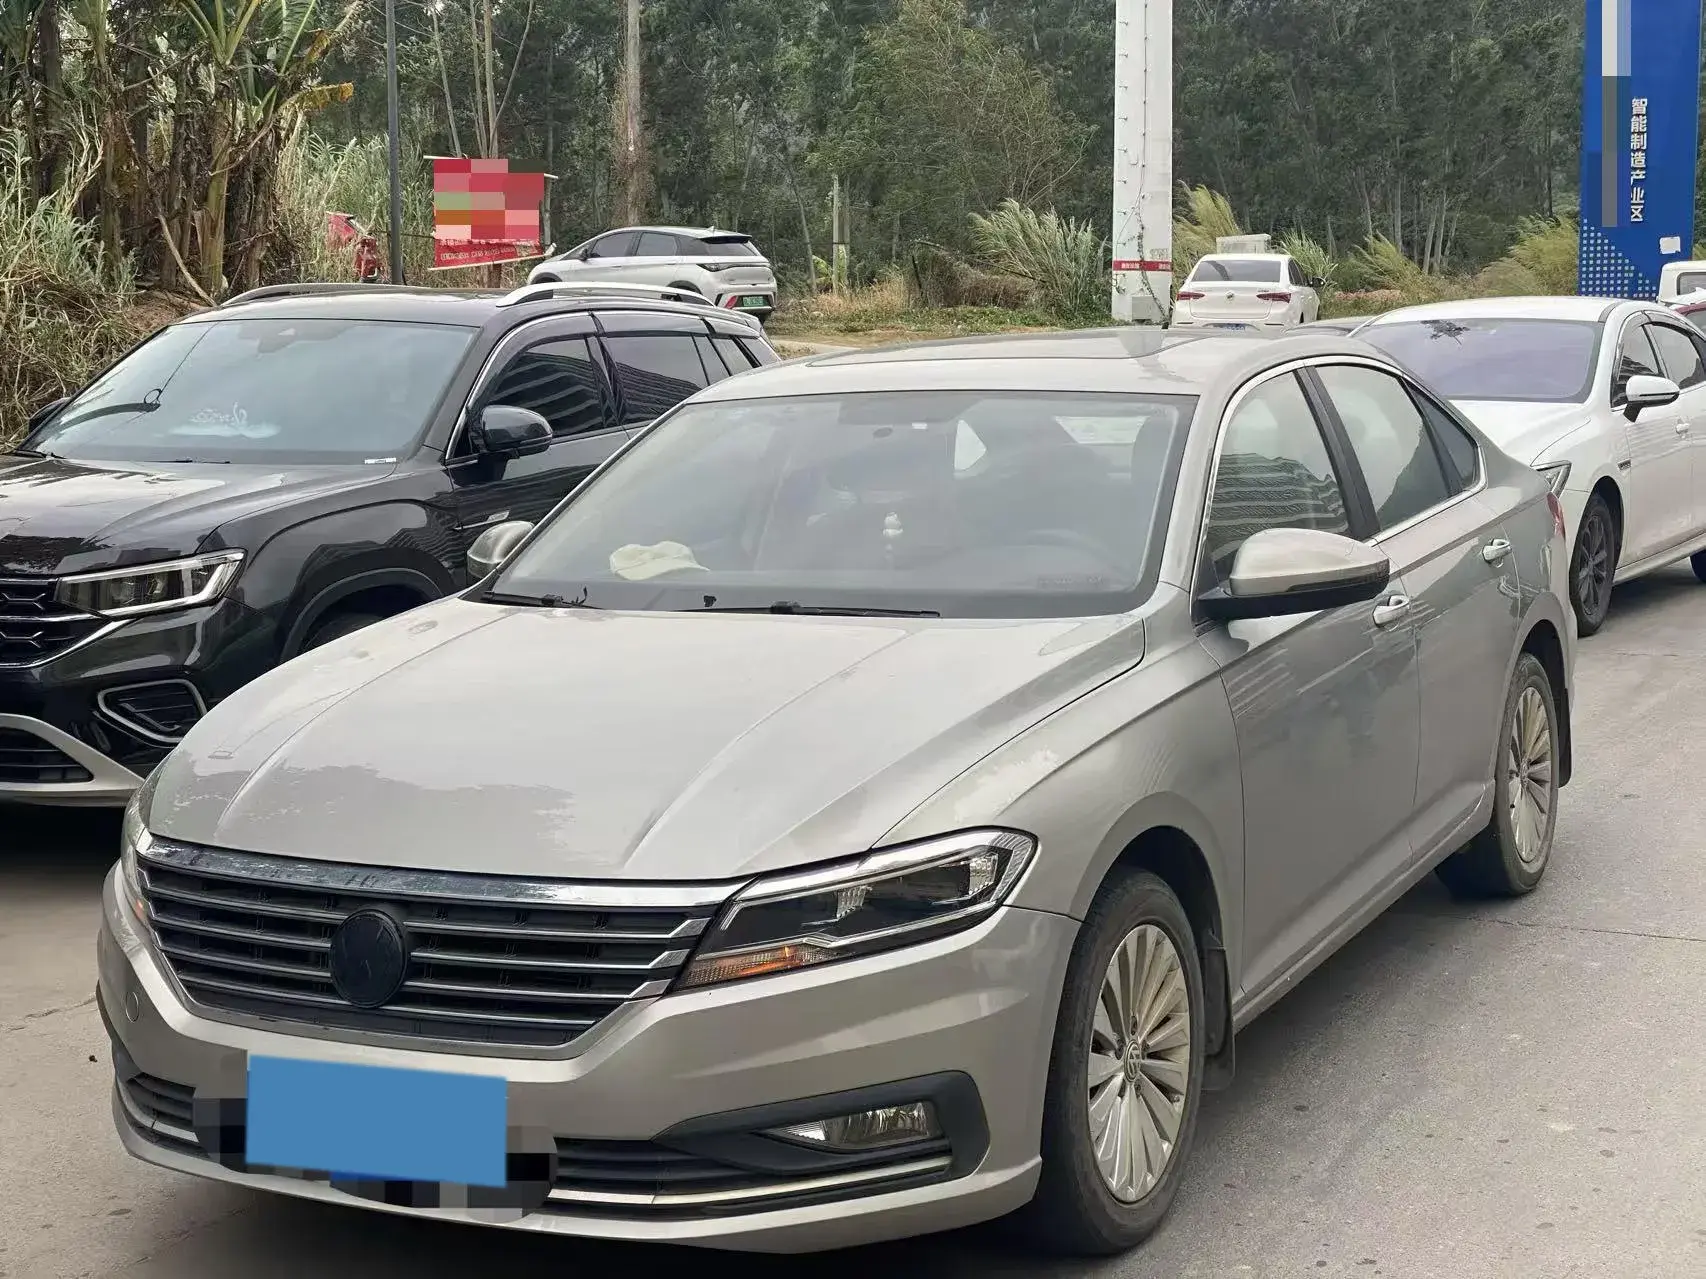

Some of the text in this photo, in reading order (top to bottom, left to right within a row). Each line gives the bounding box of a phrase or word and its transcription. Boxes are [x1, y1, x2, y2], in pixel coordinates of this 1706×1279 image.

[1630, 98, 1648, 222] 智能制造产业区
